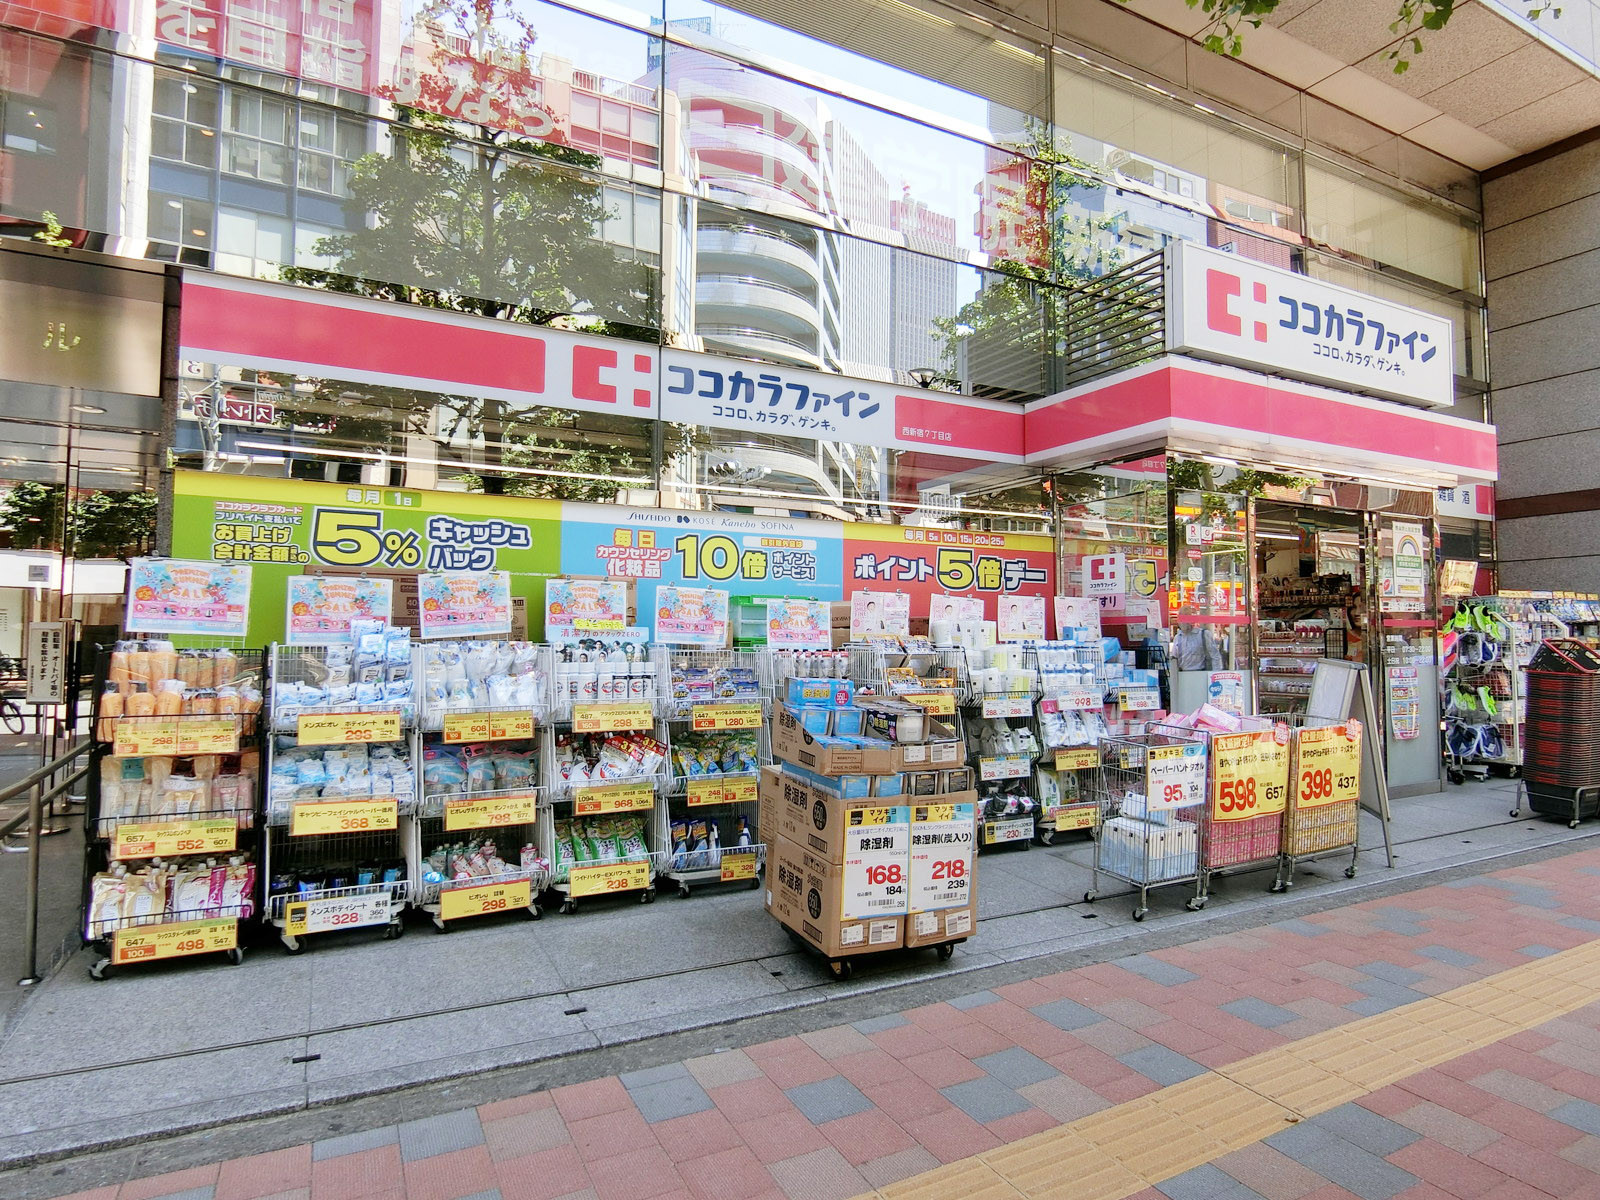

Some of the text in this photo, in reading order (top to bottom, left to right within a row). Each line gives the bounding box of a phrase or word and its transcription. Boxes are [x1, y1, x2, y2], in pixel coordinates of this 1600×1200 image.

[1278, 296, 1436, 363] ココカラファイン
[1313, 343, 1406, 377] ココロ、カラダ、ゲンキ。
[667, 365, 881, 419] ココカラファイン
[712, 405, 837, 432] ココロ、カラダ、ゲンキ。
[346, 489, 381, 503] 毎月
[626, 512, 671, 522] SHISEIDO
[721, 519, 756, 529] Kanebo
[761, 521, 794, 531] SOFINA
[215, 524, 291, 544] お買上げ
[314, 507, 422, 566] 5%
[429, 516, 531, 549] キャッシュ
[614, 528, 657, 548] 毎日
[429, 547, 496, 570] バック
[597, 545, 672, 561] カウンセリング
[676, 534, 768, 580] 10倍
[772, 551, 815, 566] ポイント
[607, 559, 662, 578] 化粧品
[613, 719, 632, 727] 298
[152, 737, 173, 745] 298
[1301, 768, 1332, 801] 398
[1338, 776, 1356, 789] 437
[1164, 784, 1183, 802] 95
[1219, 777, 1256, 812] 598
[1266, 785, 1284, 800] 657
[614, 799, 633, 808] 968
[340, 818, 369, 829] 368
[487, 813, 511, 824] 798
[939, 812, 957, 820] イイヨ
[177, 839, 205, 851] 552
[860, 836, 894, 851] 除湿剤
[912, 832, 972, 846] 除湿剤(炭入り)
[865, 864, 902, 885] 168
[931, 859, 965, 880] 218
[885, 885, 902, 895] 184
[947, 879, 965, 889] 239
[311, 902, 368, 915] メンズボディシート
[482, 898, 506, 911] 298
[331, 912, 359, 925] 328
[126, 938, 145, 946] 647
[127, 949, 145, 958] 100
[176, 939, 205, 951] 498
